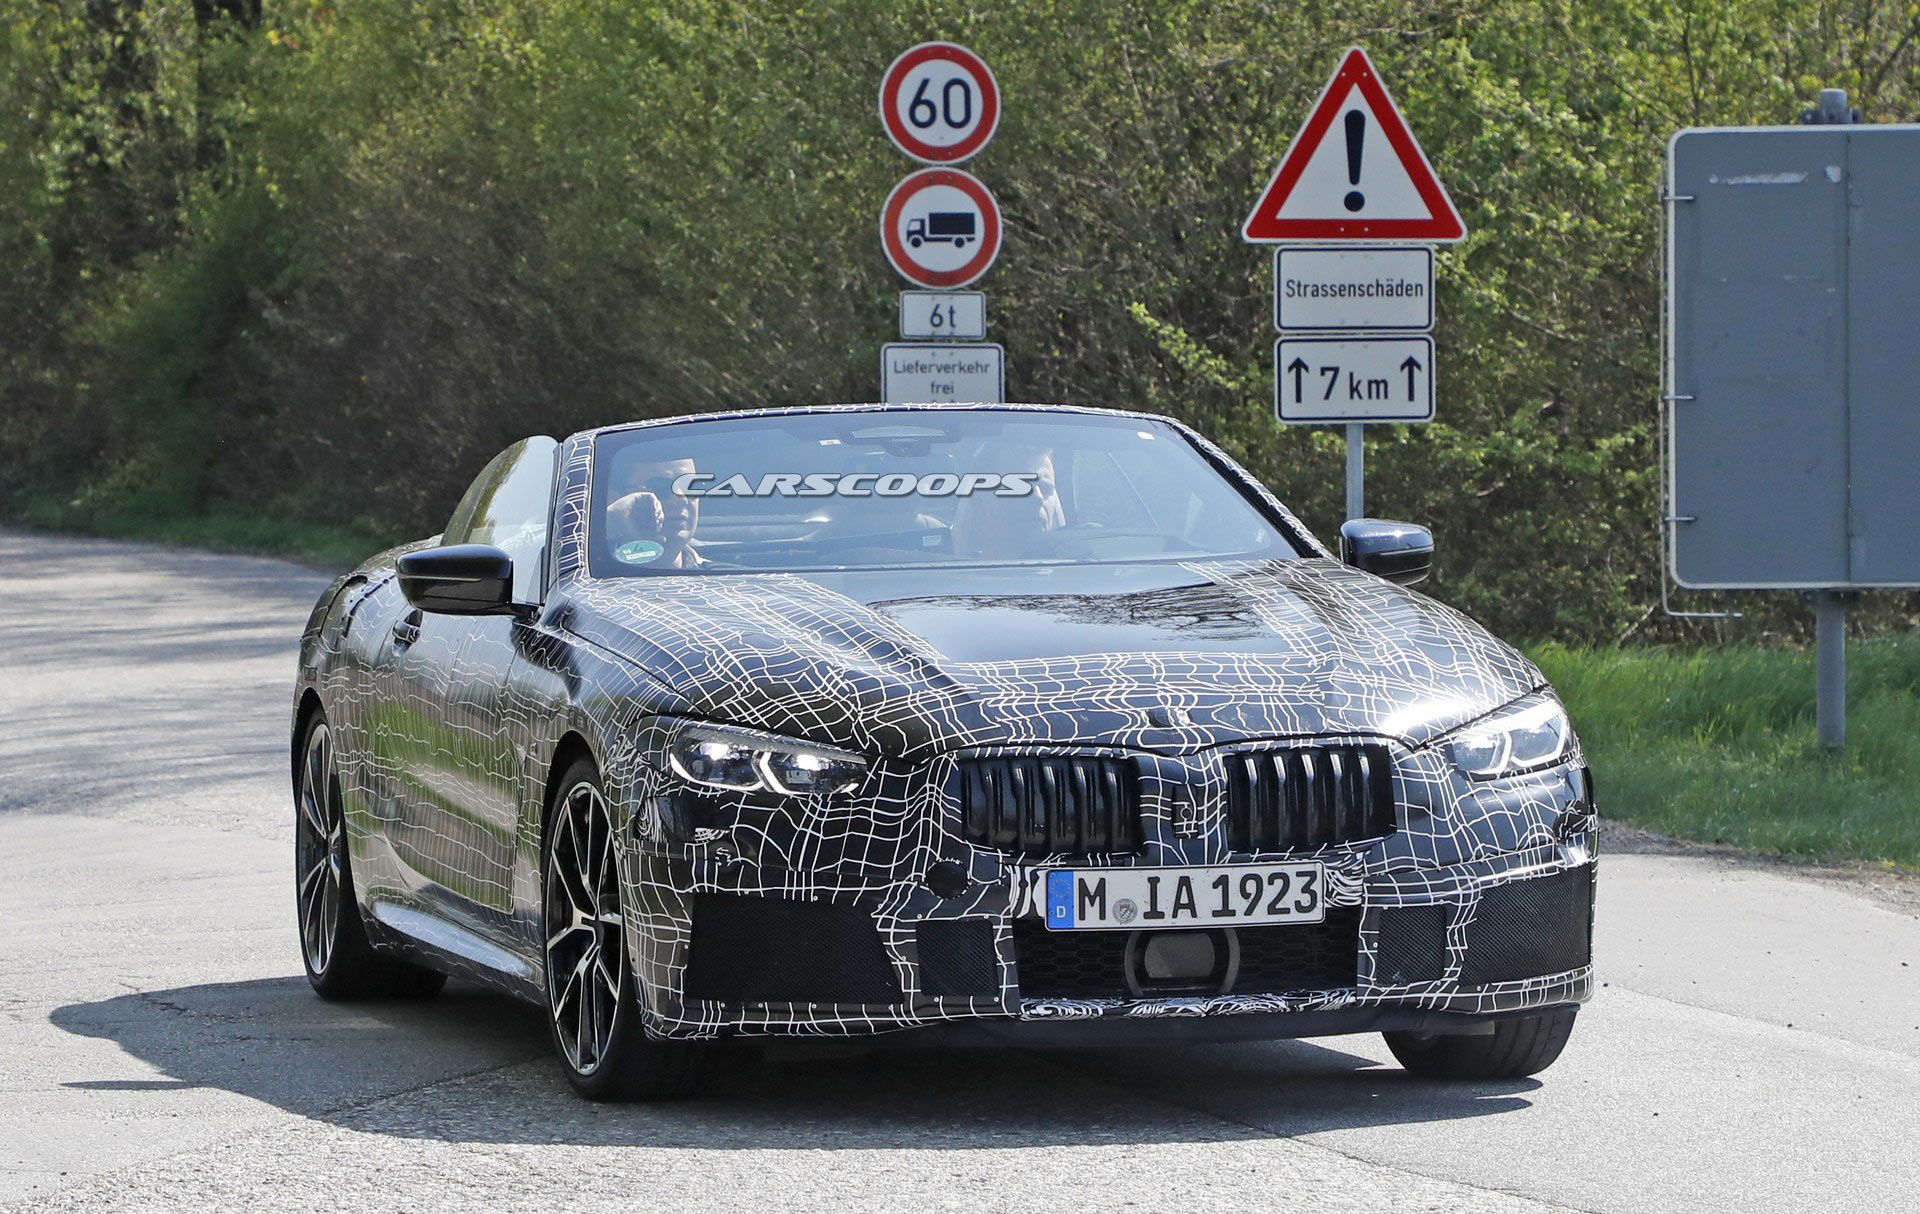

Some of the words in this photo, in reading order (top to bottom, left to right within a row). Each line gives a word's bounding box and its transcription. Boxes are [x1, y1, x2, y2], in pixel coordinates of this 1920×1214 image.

[908, 78, 972, 129] 60
[1285, 278, 1424, 298] Strassenschäden
[893, 359, 990, 375] Lieferverkehr
[930, 380, 955, 395] frei
[1319, 366, 1340, 400] 7
[1349, 371, 1389, 400] km
[1077, 877, 1107, 921] M
[1211, 870, 1318, 918] 1923
[1056, 905, 1066, 918] D
